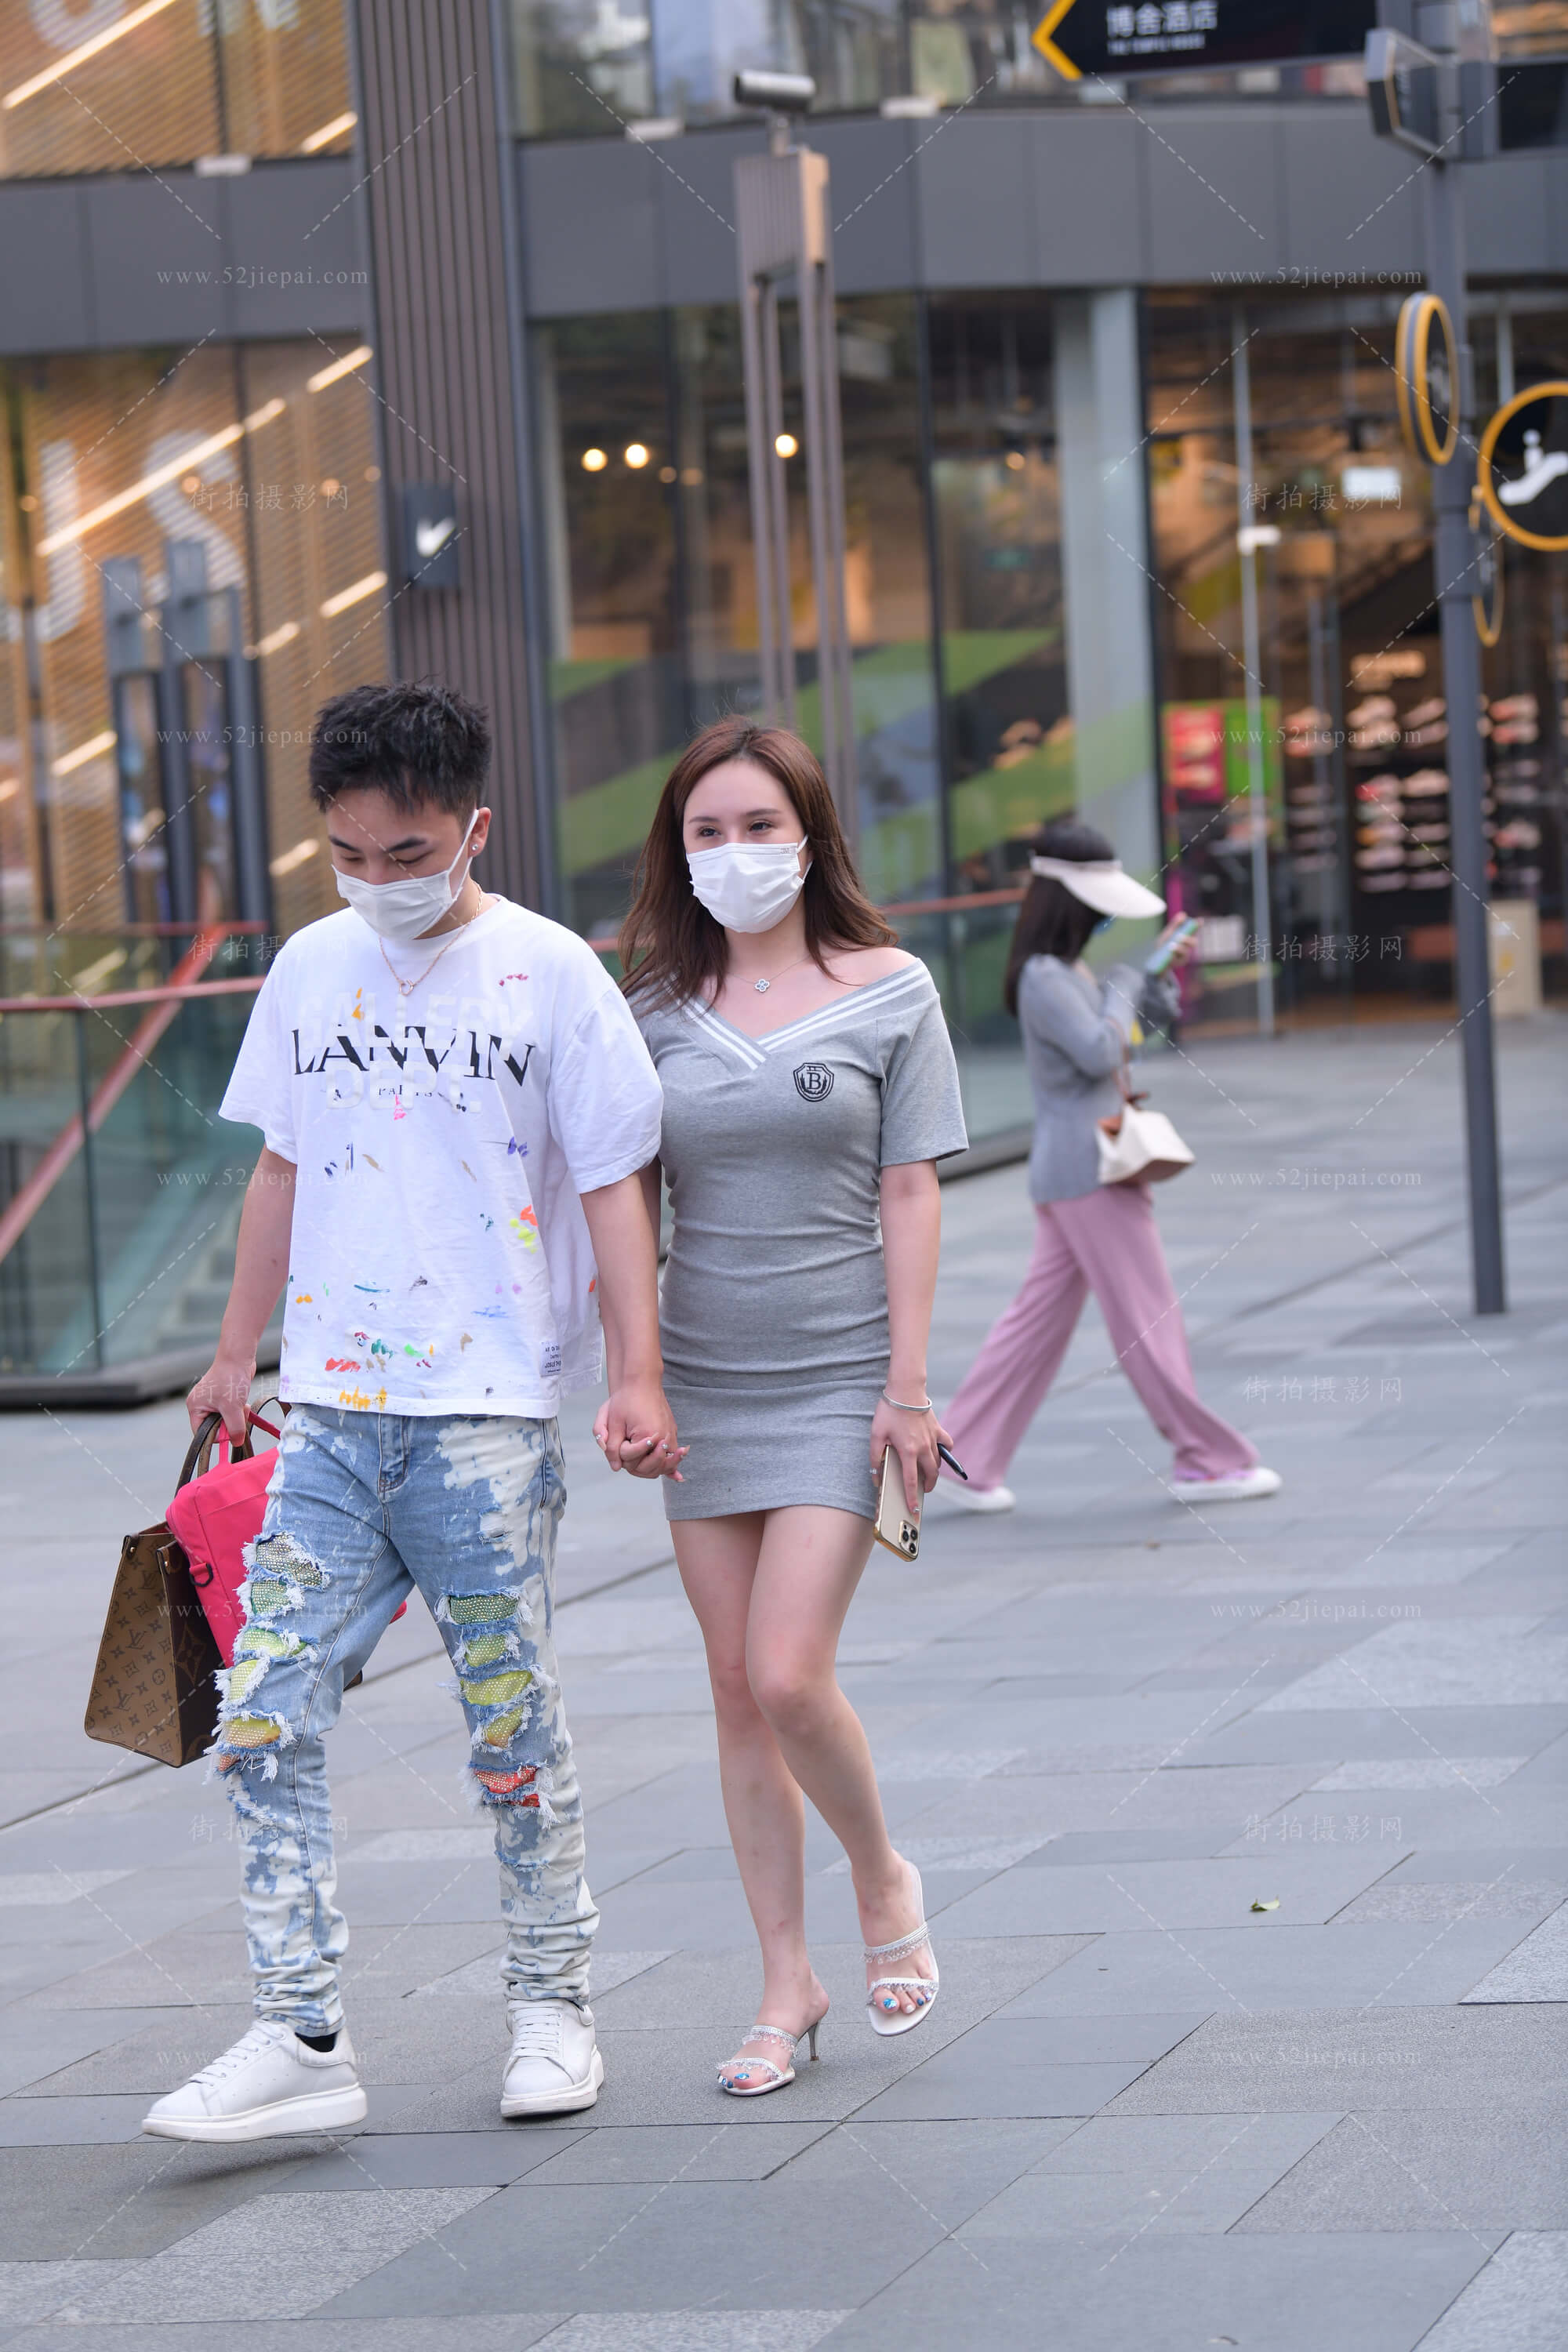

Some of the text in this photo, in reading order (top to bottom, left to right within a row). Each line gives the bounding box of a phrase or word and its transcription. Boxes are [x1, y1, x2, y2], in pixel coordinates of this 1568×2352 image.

[1107, 1, 1218, 38] 博舍酒店
[291, 1023, 537, 1087] LANVIN
